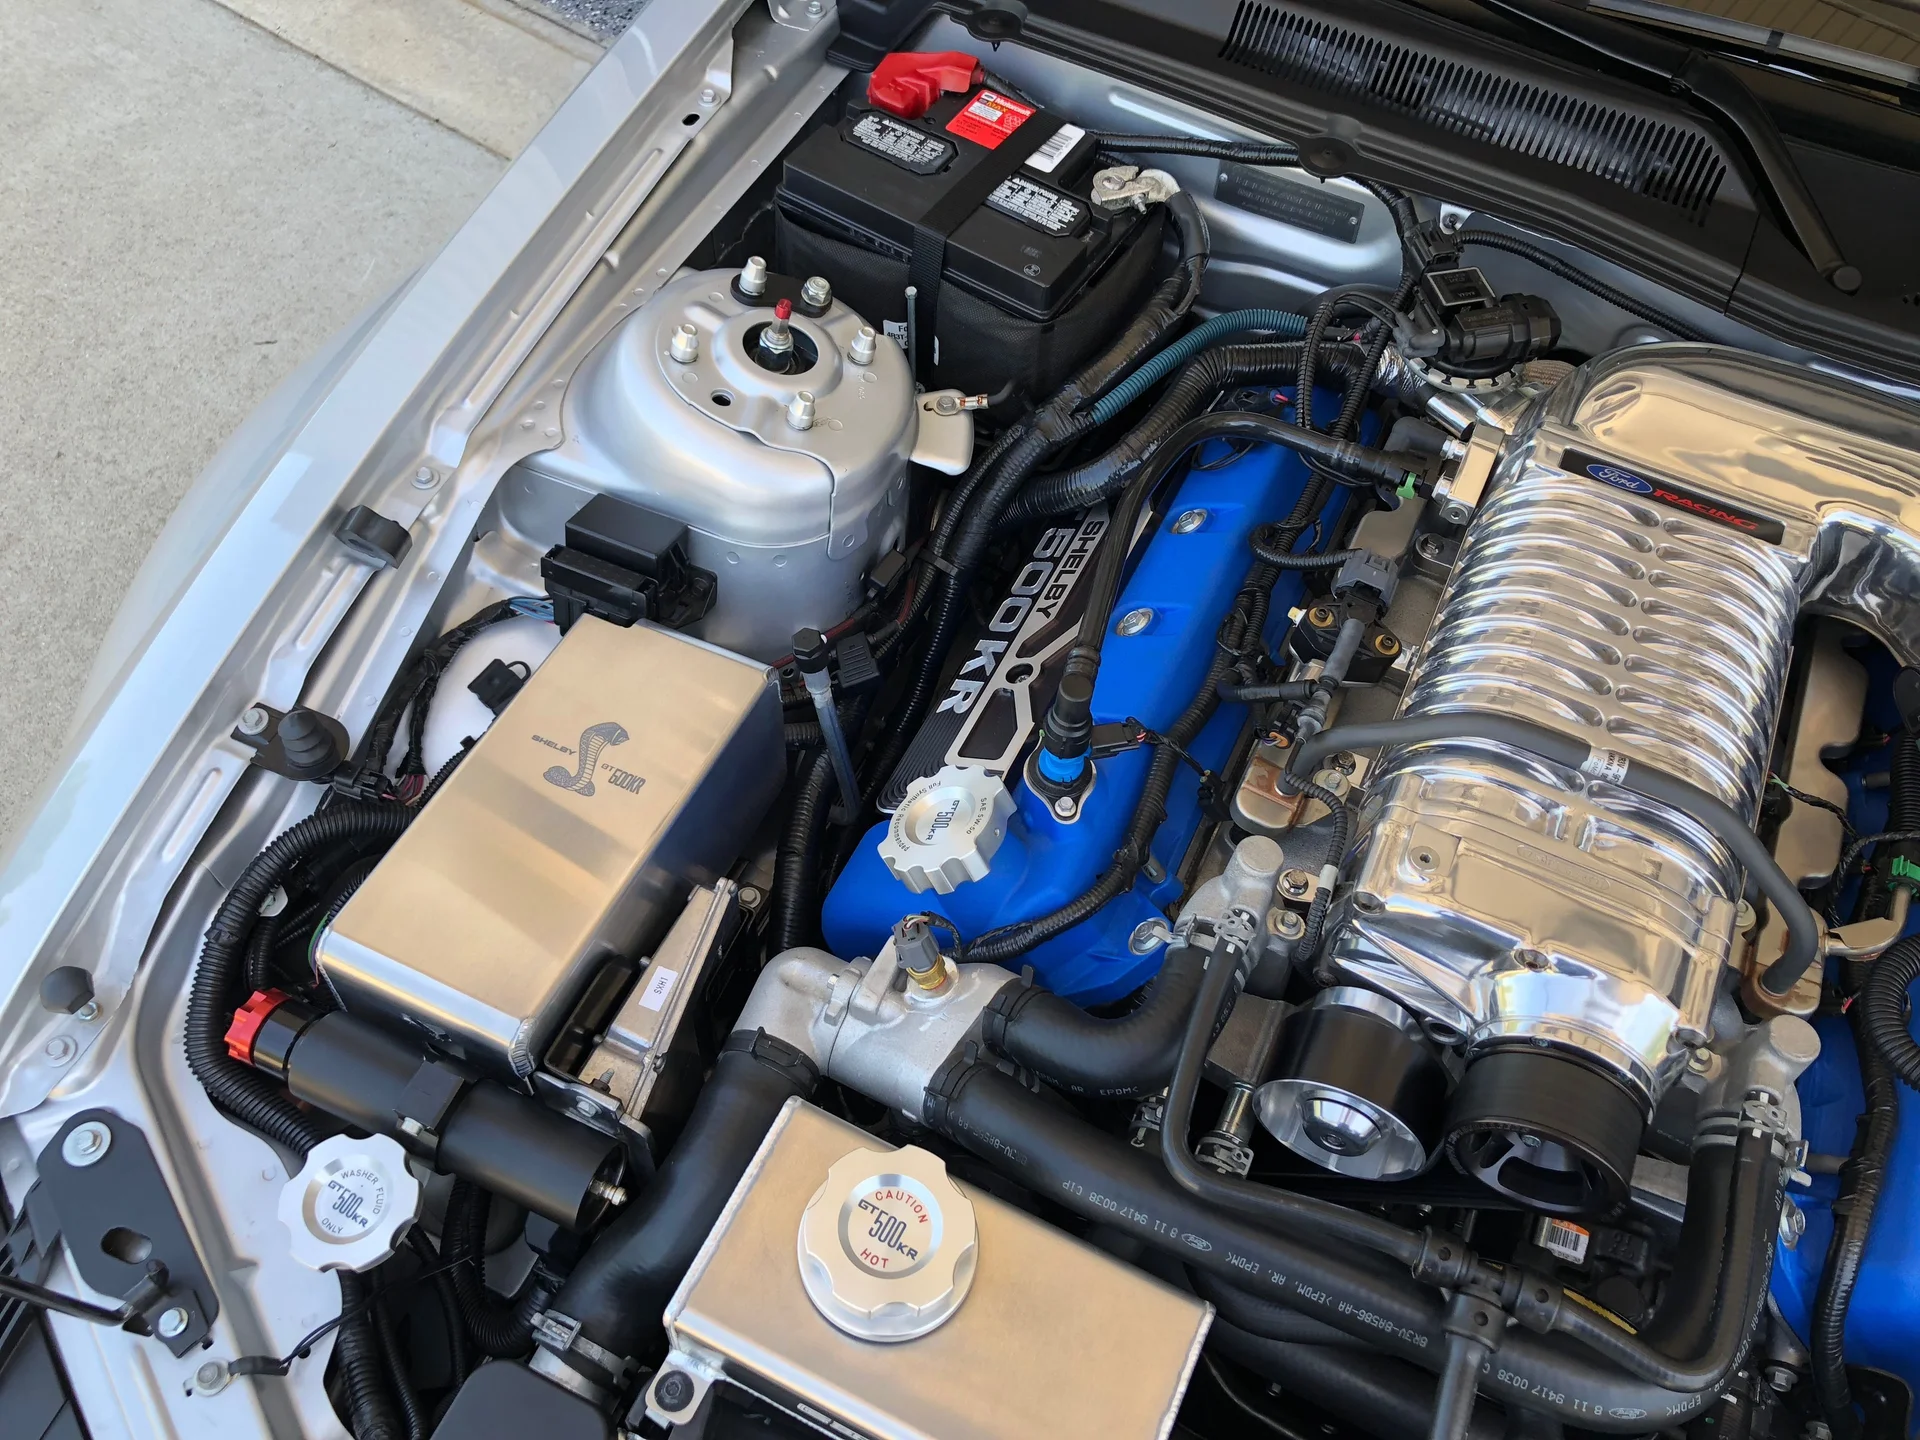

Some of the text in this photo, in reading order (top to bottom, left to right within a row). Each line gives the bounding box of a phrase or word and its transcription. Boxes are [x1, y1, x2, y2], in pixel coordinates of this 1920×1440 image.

[1594, 465, 1760, 530] Ford RACING
[1035, 520, 1104, 620] SHELBY
[531, 734, 577, 756] SHELBY
[980, 797, 988, 812] SAE
[340, 1168, 385, 1215] WASHER FLUID
[1088, 1191, 1118, 1212] 0038
[875, 1188, 930, 1224] CAUTION
[1119, 1206, 1149, 1225] 9417
[320, 1217, 344, 1235] ONLY
[1169, 1226, 1179, 1238] 8
[859, 1247, 890, 1269] HOT
[1496, 1368, 1530, 1390] 0038
[1530, 1384, 1565, 1405] 9417
[1593, 1404, 1604, 1416] 8
